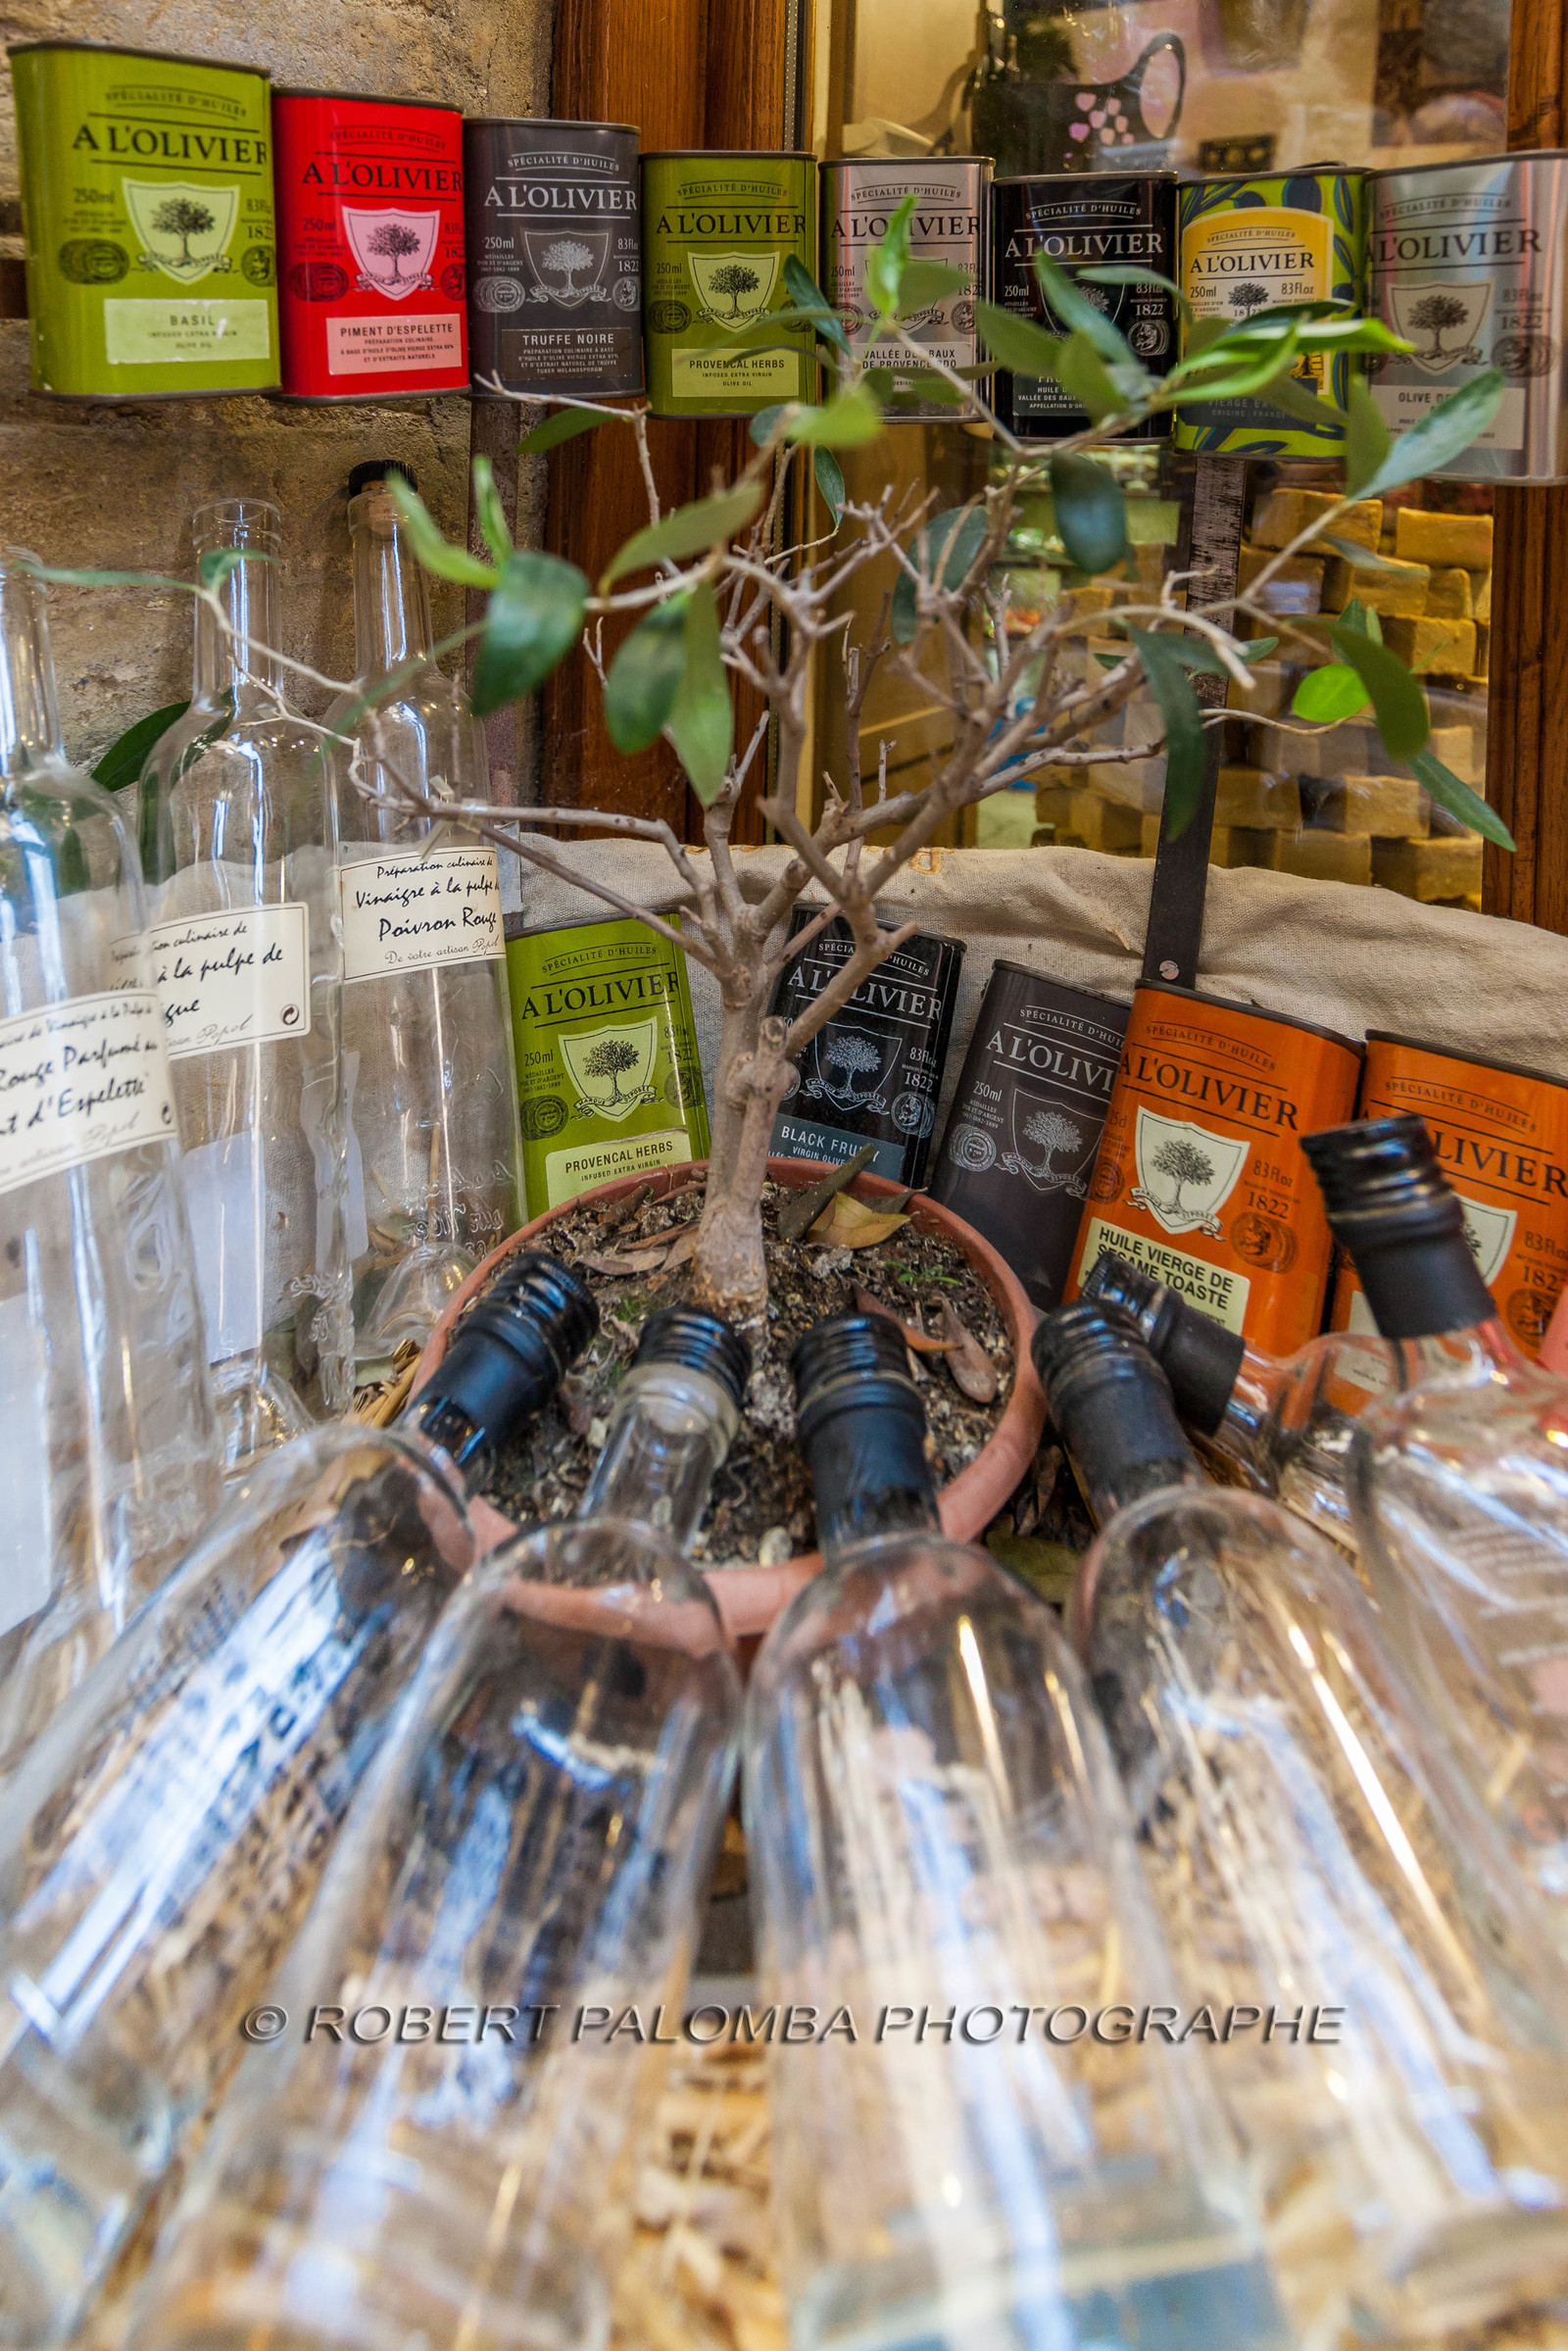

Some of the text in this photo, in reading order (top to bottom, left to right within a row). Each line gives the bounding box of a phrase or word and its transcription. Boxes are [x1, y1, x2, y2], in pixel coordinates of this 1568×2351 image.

[72, 123, 268, 166] A L'OLIVIER
[508, 155, 620, 171] SPÉCIALITÉ D'HUILES
[302, 161, 464, 193] A L'OLIVIER
[483, 184, 637, 211] A L'OLIVIER
[677, 183, 788, 196] SPÉCIALITÉ D'HUILES
[851, 186, 961, 201] SPÉCIALITÉ D'HUILES
[1025, 204, 1142, 220] SPÉCIALITÉ D'HUILES
[303, 218, 336, 231] 250ml
[656, 213, 807, 234] A L'OLIVIER
[831, 216, 981, 238] A L'OIVIER
[484, 236, 514, 250] 250ml
[1004, 232, 1164, 258] A L'OLIVIER
[1379, 228, 1542, 263] L'OLIVIER
[656, 263, 682, 274] 250ml
[831, 266, 856, 277] 250ml
[1190, 252, 1315, 273] A L'OLIVIER
[1004, 285, 1029, 297] 250ml
[1190, 285, 1217, 298] 250ml
[170, 315, 215, 326] BASIL
[1136, 304, 1164, 316] 1822
[340, 323, 453, 337] PIMENT D'ESPELETTE
[522, 333, 614, 346] TRUFFE NOIRE
[751, 359, 785, 368] HERBS
[862, 361, 875, 369] DE
[863, 348, 956, 360] VALLÉE BAUX
[1398, 392, 1431, 403] OLIVE
[376, 861, 443, 879] Préparation
[447, 857, 485, 868] culinaire
[356, 874, 493, 908] Vinaigre à la pulpe
[378, 906, 497, 942] Poivron Rouge
[172, 929, 230, 950] culinaire
[233, 921, 248, 935] de
[157, 964, 168, 984] à
[174, 956, 193, 980] la
[200, 947, 255, 982] pulpe
[263, 942, 283, 965] de
[385, 950, 403, 965] De
[436, 944, 469, 956] artisan
[542, 947, 658, 973] SPÉCIALITÉ D'HUILES
[818, 942, 930, 976] SPÉCIA 'HUILES
[521, 971, 679, 1020] A L'OLIVIER
[788, 966, 943, 1020] A L'LIVIER
[1020, 1008, 1124, 1048] SPÉCIALITÉ D'HUI
[524, 1049, 554, 1066] 250ml
[1146, 1025, 1276, 1071] SPÉCIALITÉ D'HUILES
[986, 1030, 1114, 1093] A L'OLIVI
[905, 1071, 934, 1093] 1822
[973, 1080, 1003, 1102] 250ml
[1118, 1052, 1298, 1131] A L'OLIVIER
[1385, 1081, 1538, 1133] SPÉCIALITÉ D'HUILES
[781, 1125, 826, 1150] BLACK
[565, 1141, 673, 1174] PROVENCAL HERBS
[792, 1146, 819, 1160] VIRGIN
[822, 1153, 846, 1166] OLIVE
[1433, 1129, 1568, 1199] LIVIER
[581, 1158, 662, 1182] INFUSED EXTRA VIRGIN
[1248, 1191, 1290, 1219] 1822
[1099, 1227, 1234, 1294] HUILE VIERGE DE
[1163, 1271, 1229, 1310] TOASTE
